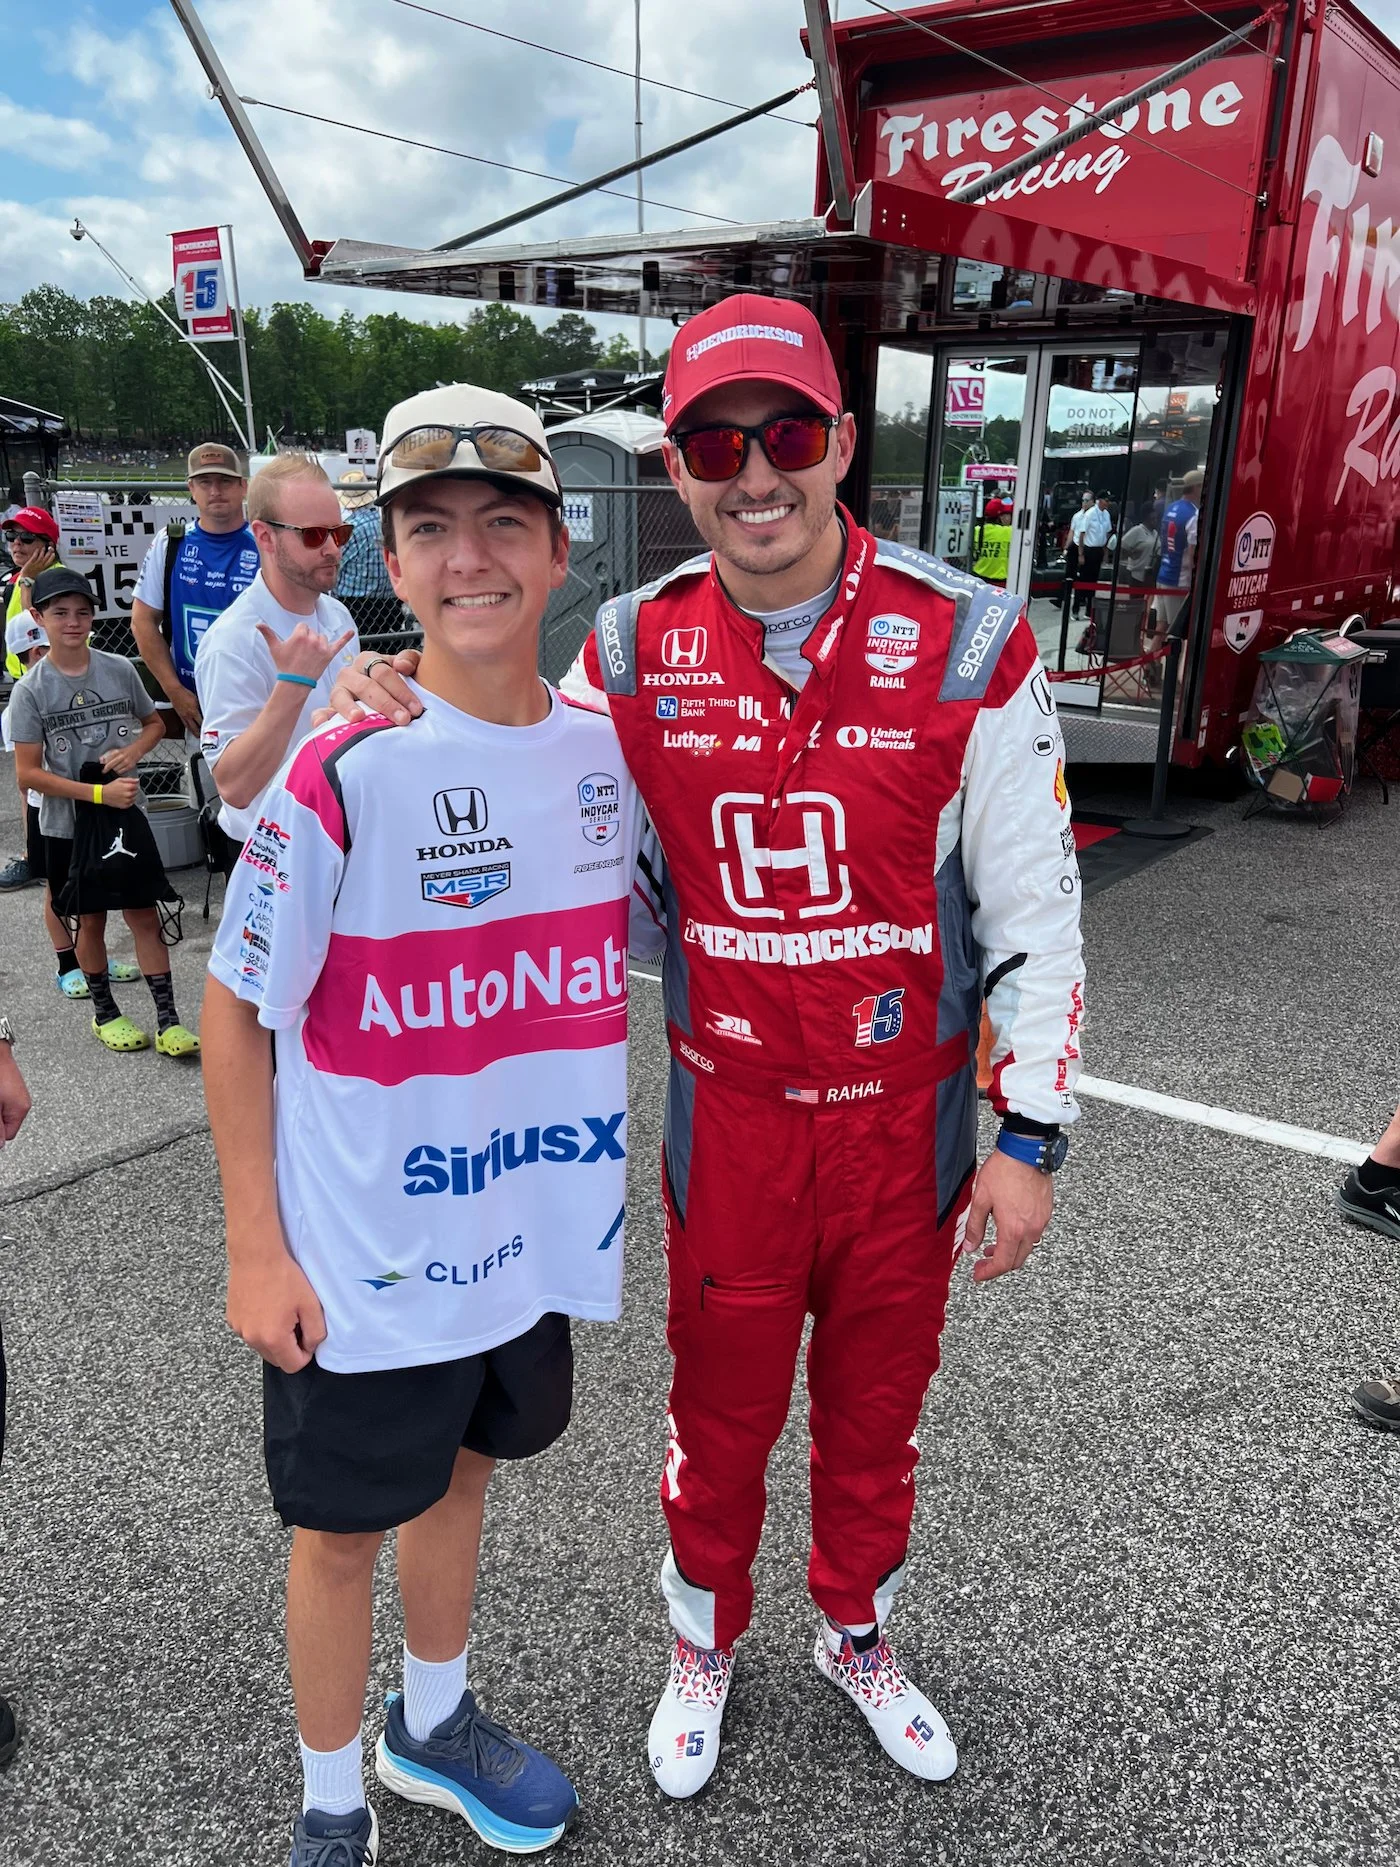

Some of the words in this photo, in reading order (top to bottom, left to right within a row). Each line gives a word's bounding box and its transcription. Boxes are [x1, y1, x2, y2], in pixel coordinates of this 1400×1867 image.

[880, 80, 1244, 178] Firestone
[940, 144, 1132, 206] Racing
[181, 268, 218, 312] 15
[698, 324, 804, 348] HENDRICKSON
[1067, 408, 1086, 419] DO
[1088, 408, 1117, 419] NOT
[400, 427, 448, 453] THERE
[1068, 424, 1111, 437] ENTER
[105, 545, 129, 558] ATE
[1251, 537, 1272, 559] NTT
[85, 563, 138, 612] 15
[1227, 573, 1269, 598] INDYCAR
[1233, 595, 1259, 609] SERIES
[765, 615, 812, 634] parco
[892, 625, 916, 637] NTT
[601, 607, 627, 678] sparco
[866, 638, 919, 651] INDYCAR
[876, 647, 908, 656] SERIES
[958, 604, 1008, 681] sparco
[642, 671, 726, 687] HONDA
[869, 675, 907, 690] RAHAL
[681, 699, 706, 708] FIFTH
[708, 698, 737, 708] THIRD
[681, 708, 706, 717] BANK
[663, 729, 718, 749] Luther
[868, 736, 916, 751] Rentals
[869, 726, 914, 742] United
[596, 784, 616, 798] NTT
[580, 802, 619, 819] INDYCAR
[589, 815, 612, 824] SERIES
[416, 837, 514, 861] HONDA
[423, 871, 452, 880] MEYER
[452, 866, 481, 877] SHANK
[481, 862, 510, 874] RACING
[426, 872, 508, 896] MSR
[698, 922, 933, 966] HENDRICKSON
[359, 935, 627, 1038] AutoNat
[852, 988, 905, 1048] 15
[679, 1040, 716, 1073] sparco
[826, 1080, 884, 1103] RAHAL
[403, 1111, 627, 1197] SiriusX
[425, 1234, 524, 1286] CLIFFS
[905, 1714, 935, 1751] 15
[675, 1729, 705, 1759] 15
